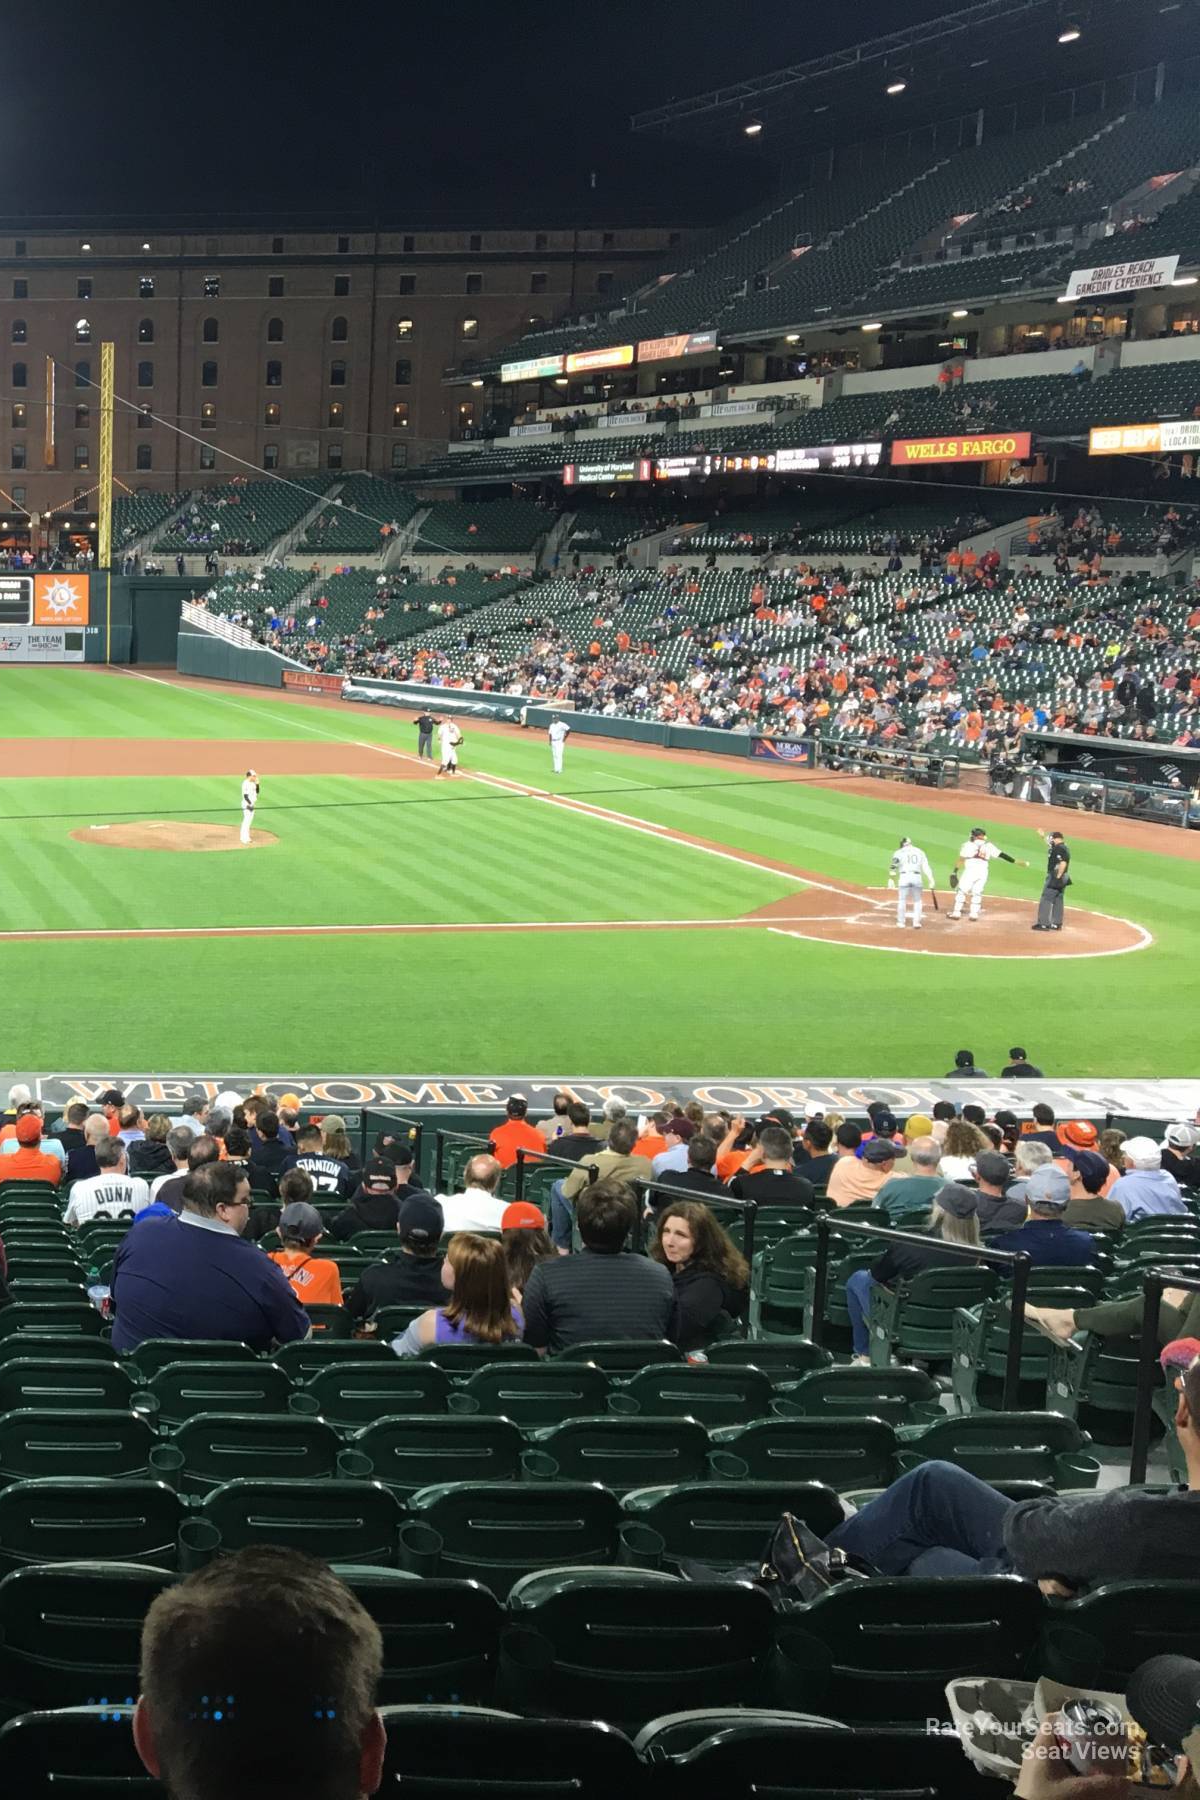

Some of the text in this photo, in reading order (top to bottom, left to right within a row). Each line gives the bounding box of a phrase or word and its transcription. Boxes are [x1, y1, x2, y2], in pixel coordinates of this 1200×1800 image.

[1091, 265, 1125, 281] ORIOLES
[1076, 272, 1164, 295] GAMEDAY EXPERIENCE
[905, 438, 1016, 460] WELLS FARGO
[611, 462, 634, 472] Maryland
[579, 474, 598, 482] Medical
[776, 742, 802, 752] MORGAN
[531, 1084, 665, 1107] TO
[296, 1158, 342, 1177] STANTON
[94, 1186, 133, 1205] DUNN
